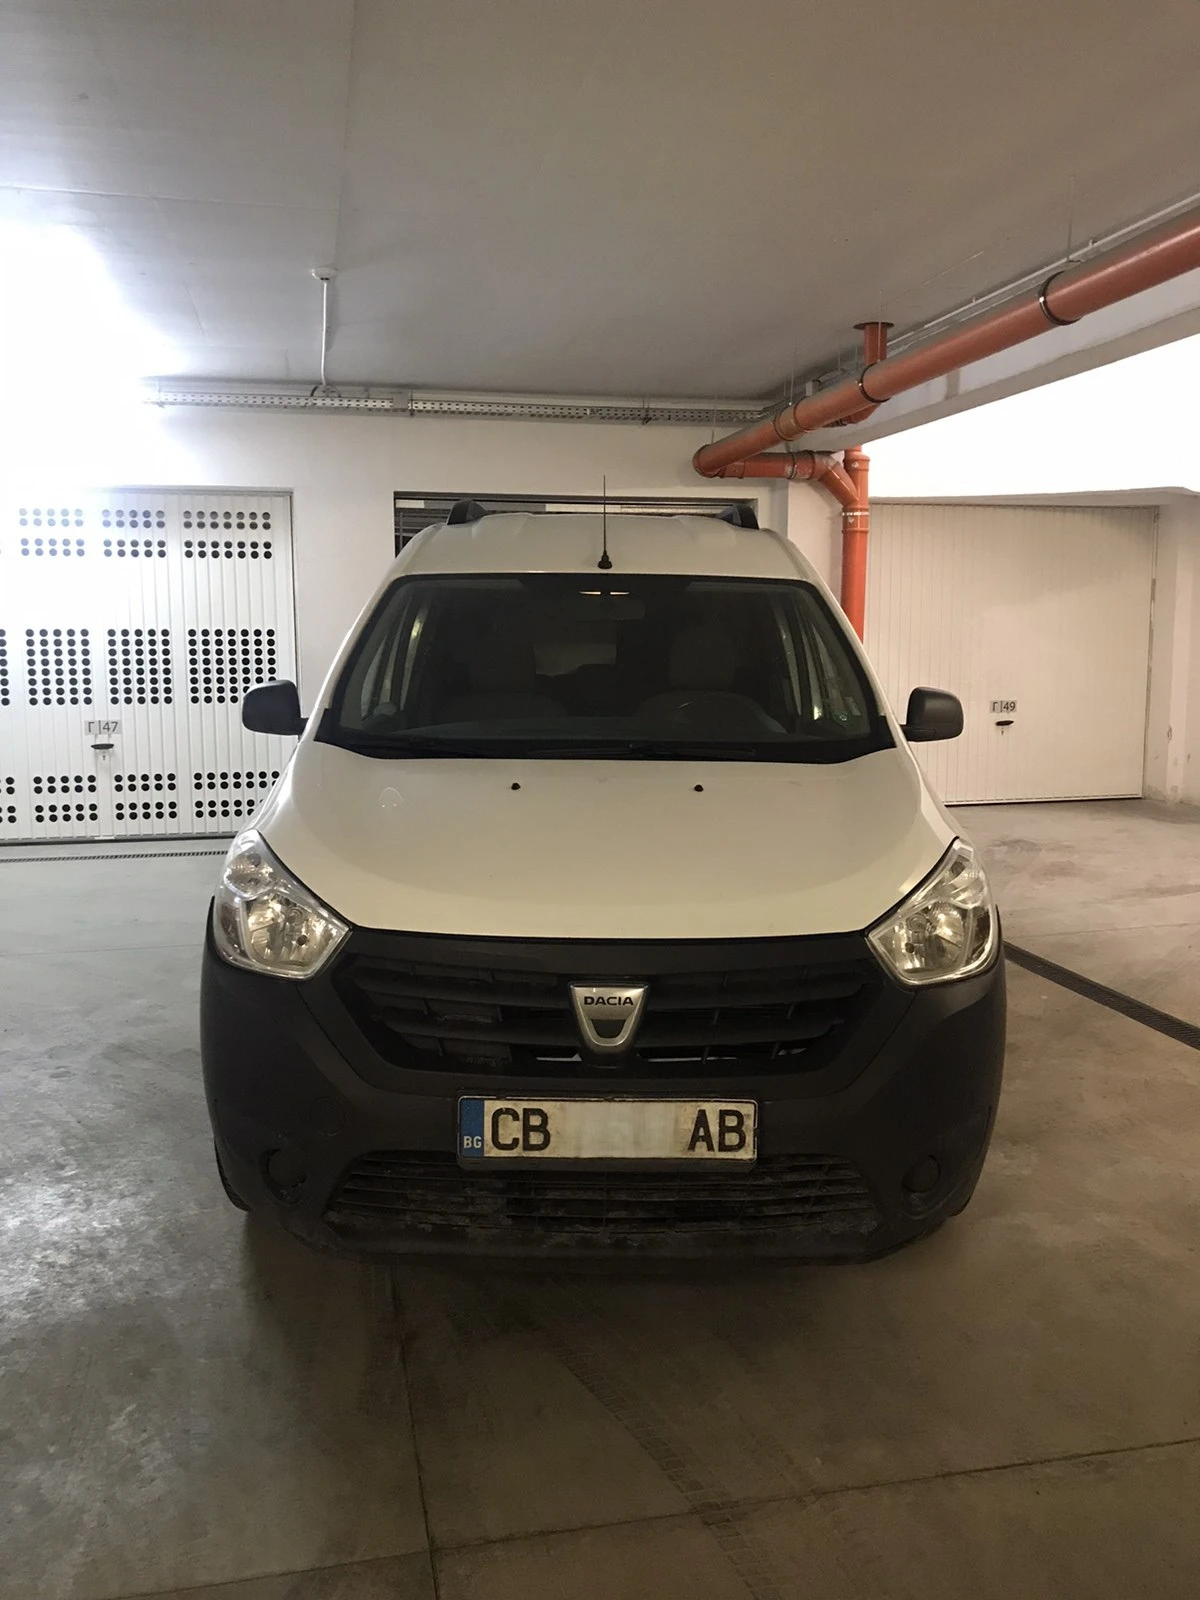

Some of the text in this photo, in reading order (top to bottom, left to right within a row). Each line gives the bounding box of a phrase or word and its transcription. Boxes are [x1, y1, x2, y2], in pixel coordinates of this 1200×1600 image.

[1003, 701, 1016, 711] 49
[102, 721, 118, 732] 47
[583, 996, 634, 1006] DACIA
[491, 1107, 747, 1152] CB AB
[463, 1135, 482, 1148] BG
